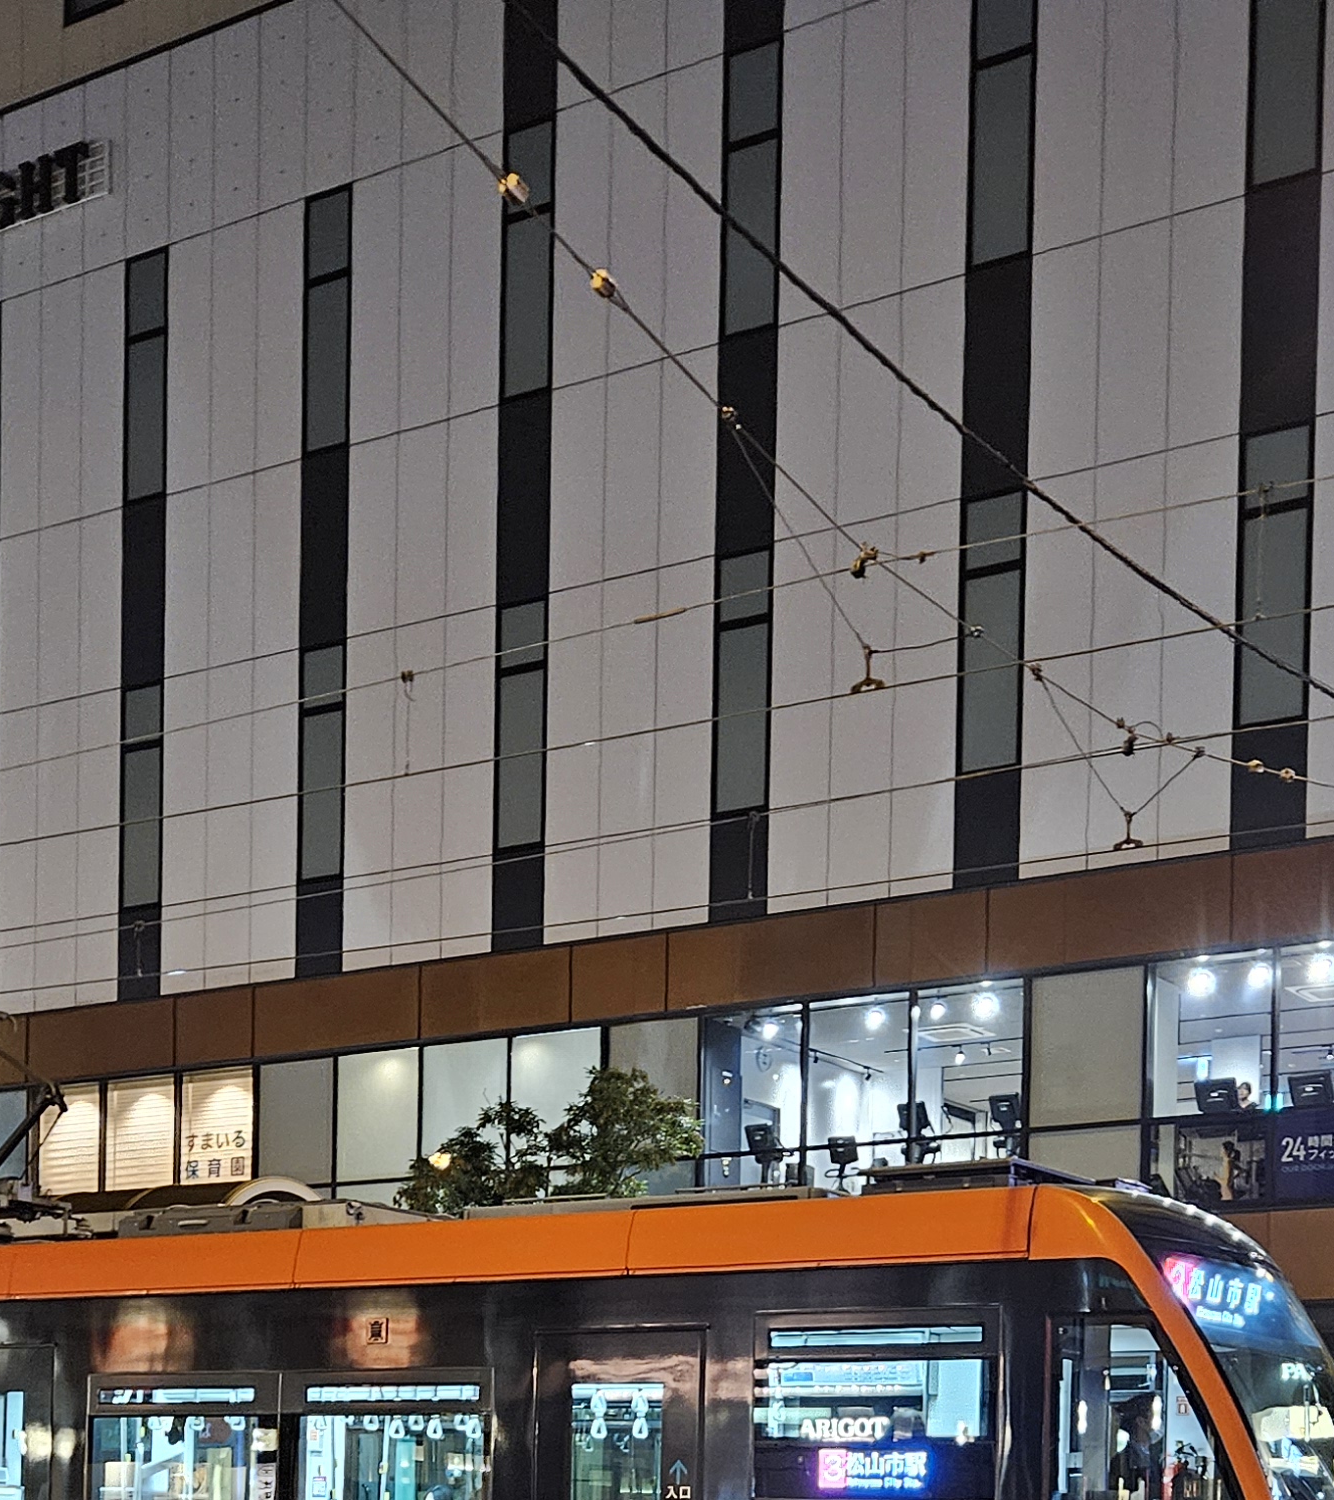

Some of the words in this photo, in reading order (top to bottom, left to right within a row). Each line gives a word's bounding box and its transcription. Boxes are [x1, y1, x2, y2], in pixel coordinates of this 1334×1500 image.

[185, 1130, 246, 1152] すまいる
[1281, 1136, 1306, 1162] 24
[185, 1156, 246, 1179] 保育園
[800, 1416, 890, 1442] ARIGOT
[846, 1451, 927, 1477] 松山市駅
[665, 1485, 691, 1499] 入口
